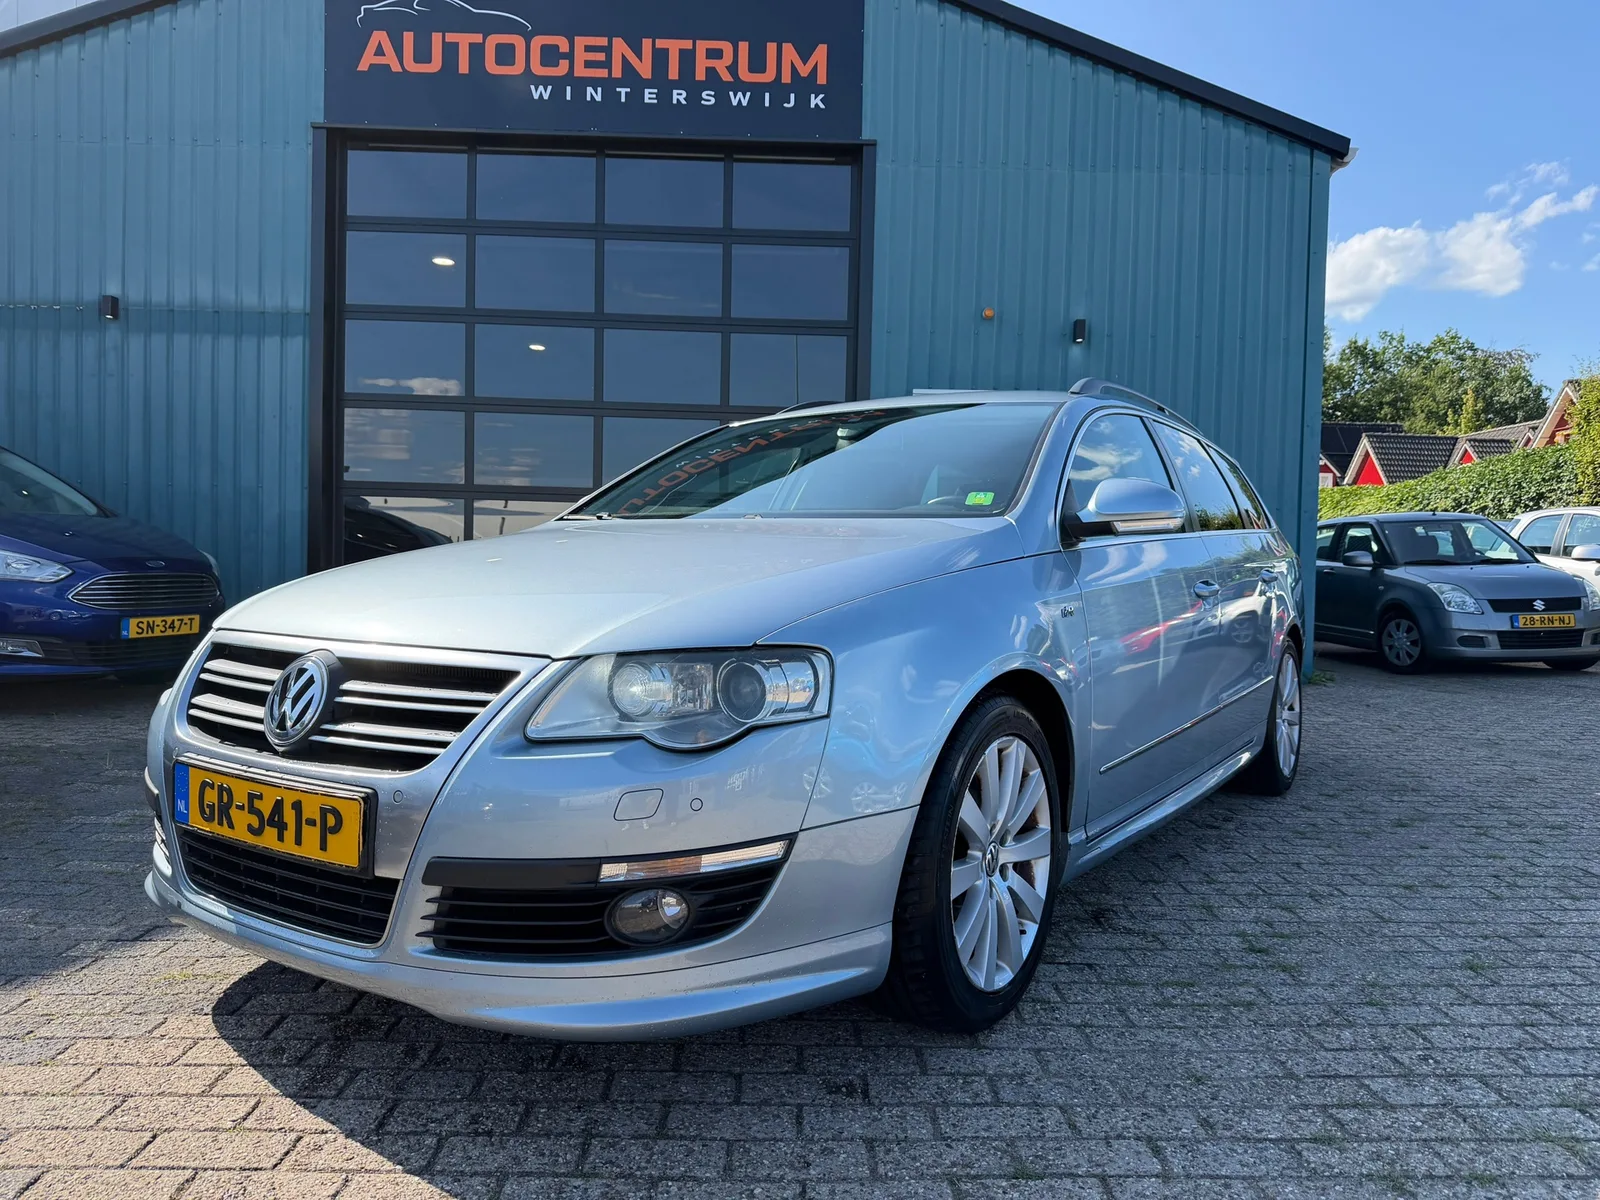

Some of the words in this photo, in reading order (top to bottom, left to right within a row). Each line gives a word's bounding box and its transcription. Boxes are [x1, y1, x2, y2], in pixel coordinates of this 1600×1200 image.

[356, 30, 828, 85] AUTOCENTRUM
[530, 84, 826, 109] WINTERSWIJK
[135, 617, 195, 635] SN-347-T
[1521, 615, 1571, 626] 28-RN-NJ
[177, 798, 188, 814] NL
[197, 777, 343, 852] GR-541-P
